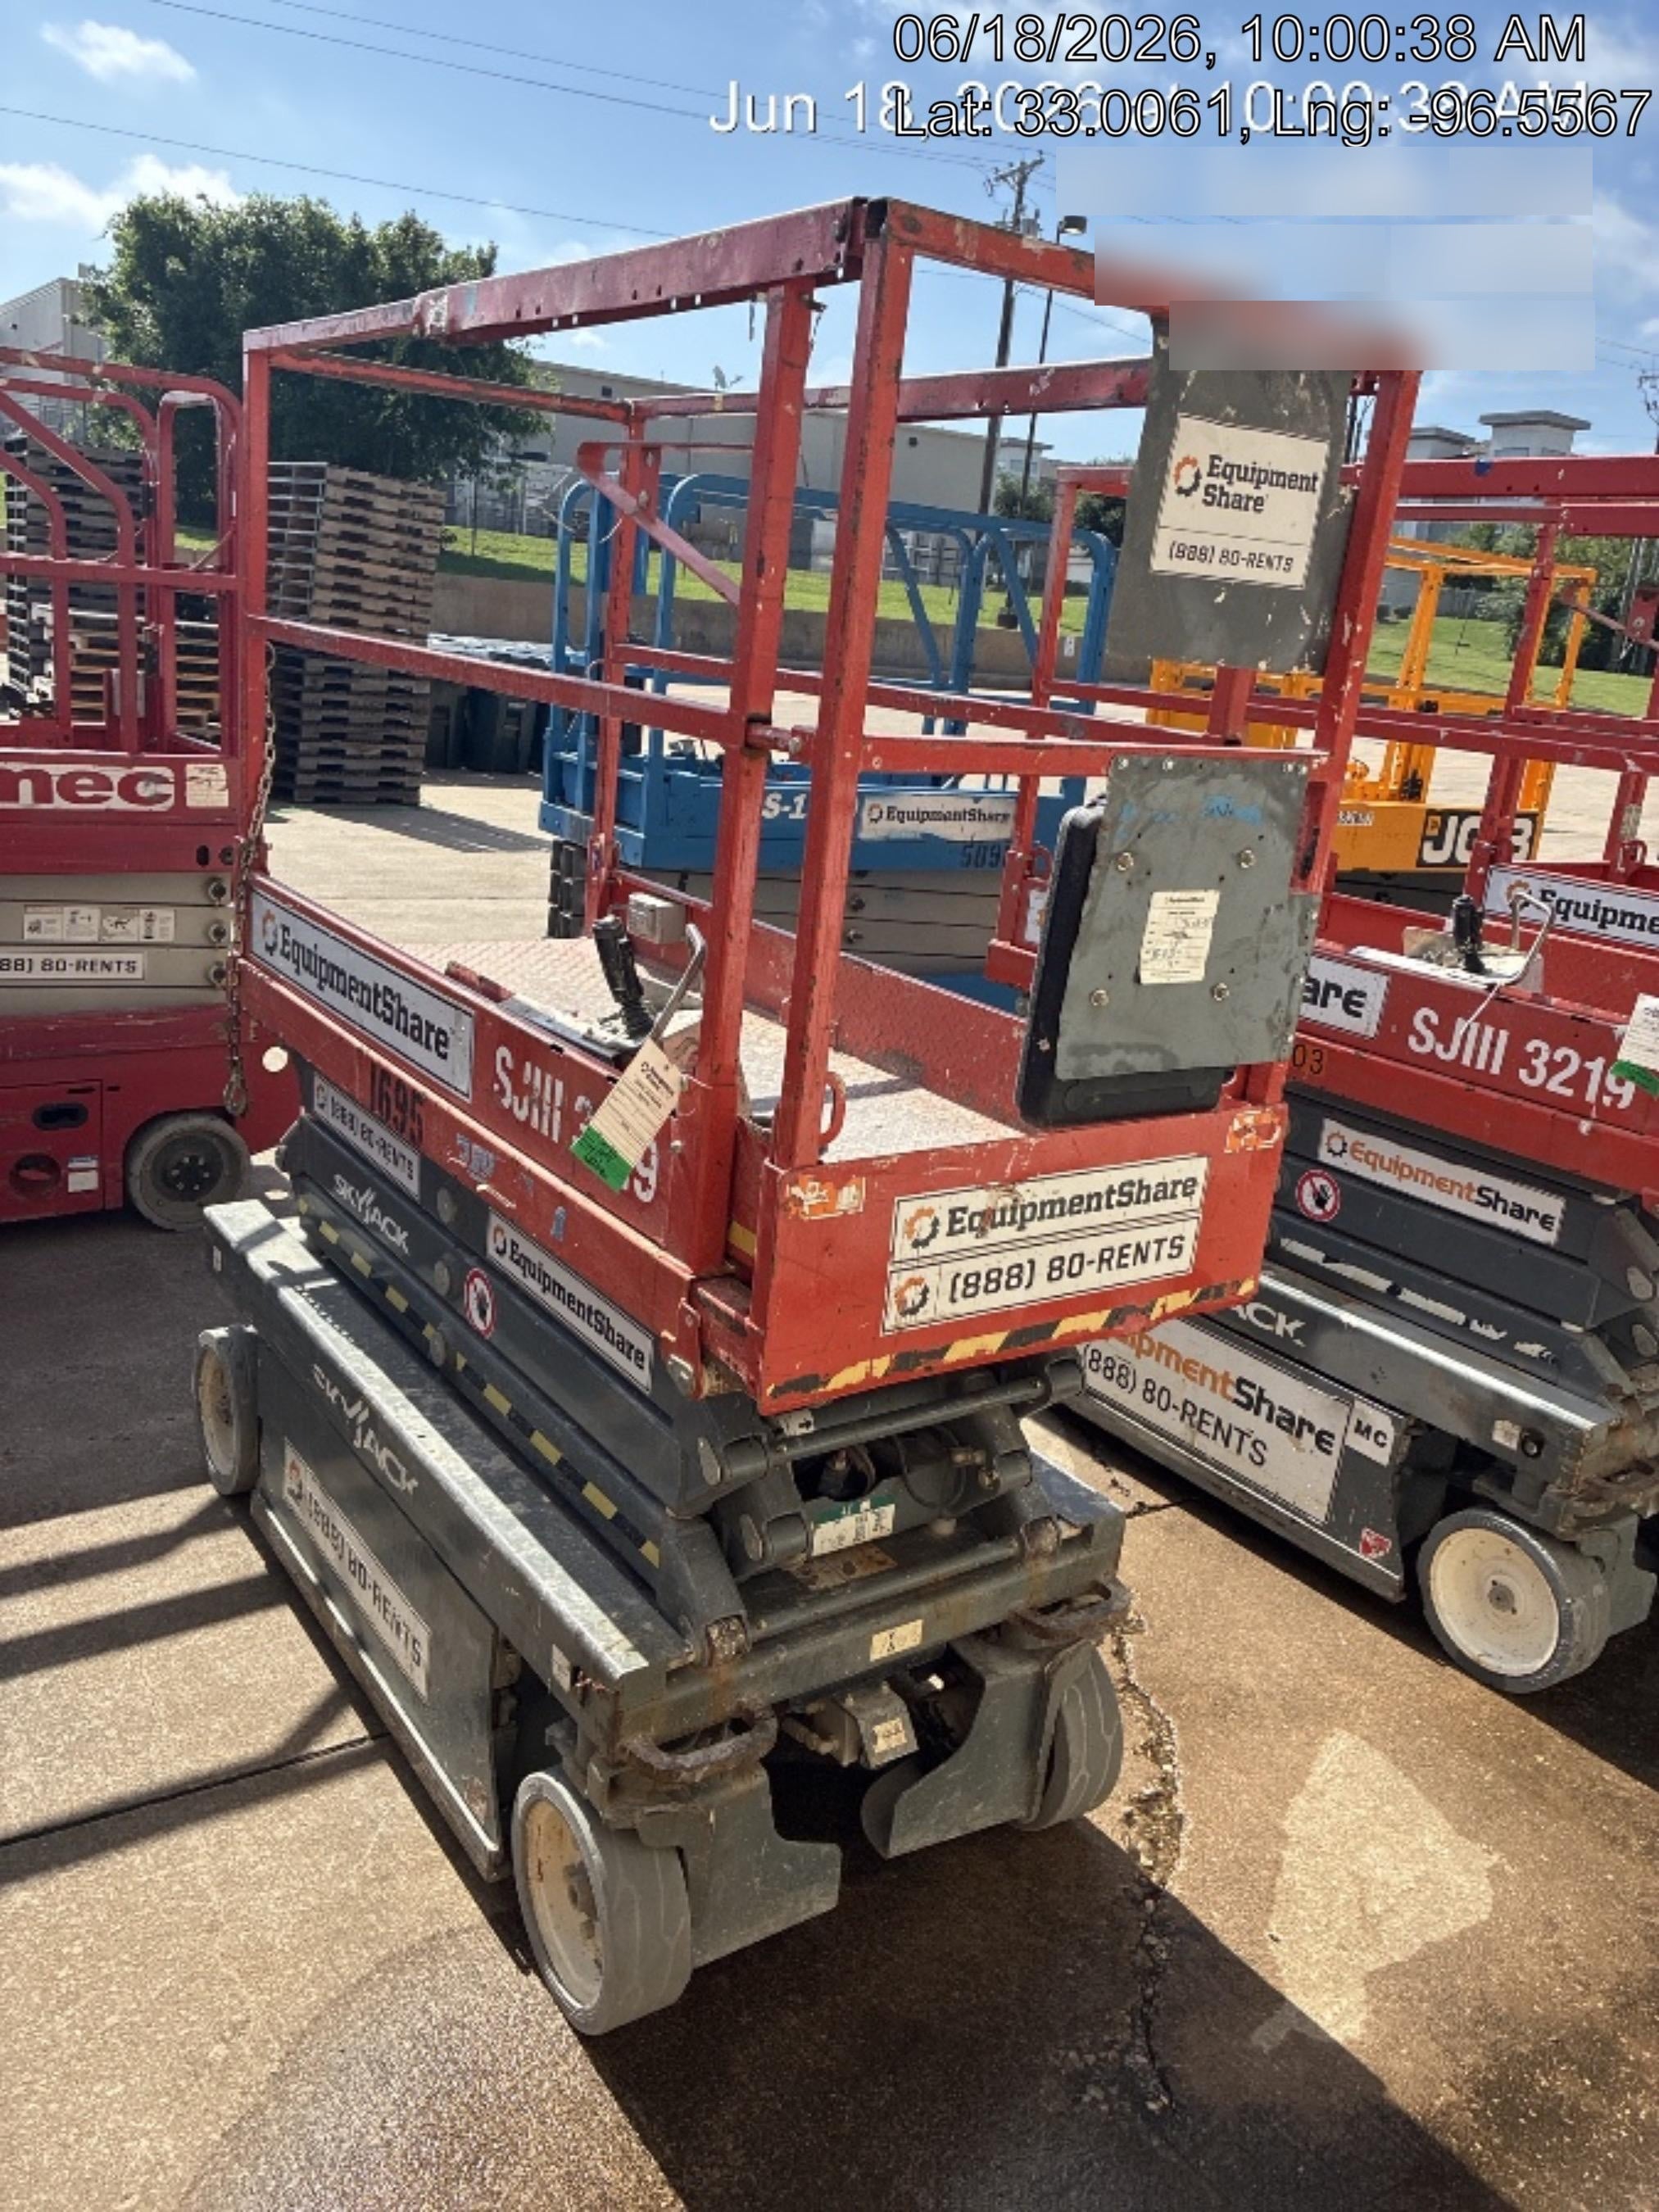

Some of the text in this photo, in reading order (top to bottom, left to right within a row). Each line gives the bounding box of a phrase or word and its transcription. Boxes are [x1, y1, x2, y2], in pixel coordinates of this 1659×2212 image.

[1201, 483, 1265, 514] Share
[1206, 454, 1318, 494] Equipment
[1168, 539, 1294, 573] (888) 80-RENTS
[886, 805, 1012, 824] EquipmentShare
[41, 958, 138, 973] 80-RENTS
[279, 923, 450, 1061] EquipmentShare
[1407, 1005, 1510, 1075] SJIII
[945, 1176, 1199, 1239] EquipmentShare
[1349, 1139, 1557, 1232] EquipmentShare
[948, 1234, 1186, 1304] (888) 80-RENTS
[510, 1238, 646, 1371] EquipmentShare
[1082, 1344, 1269, 1467] (888) 80-RENTS
[1353, 1418, 1389, 1448] MC
